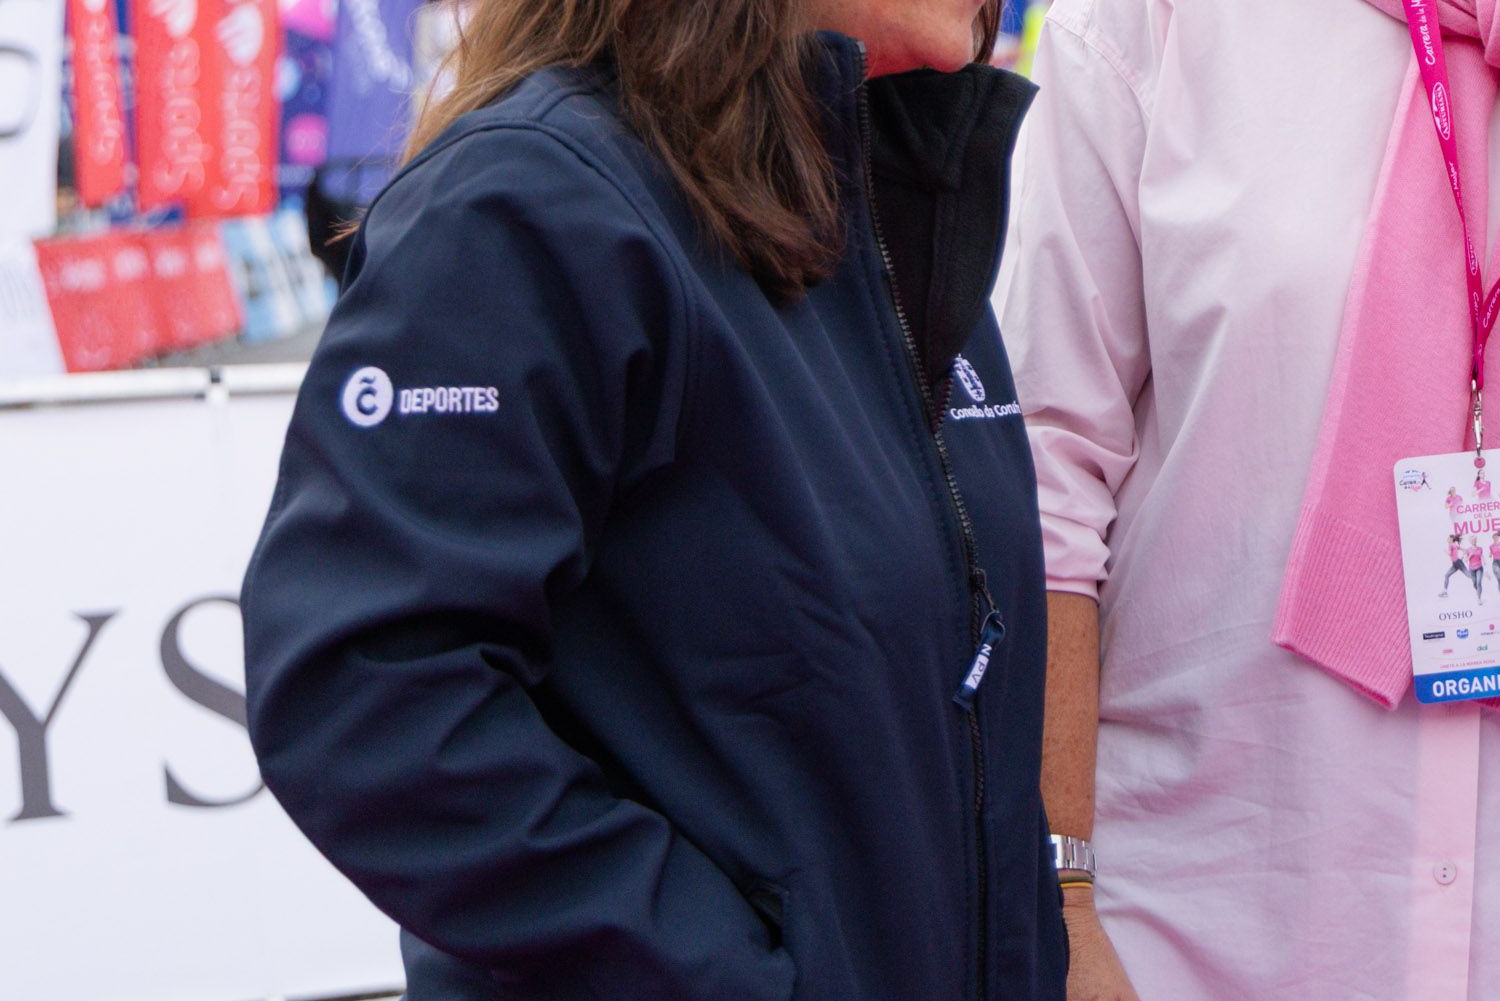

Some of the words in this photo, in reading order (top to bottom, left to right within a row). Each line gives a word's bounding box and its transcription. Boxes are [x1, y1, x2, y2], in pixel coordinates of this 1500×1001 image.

[1420, 25, 1436, 66] Carrera
[1482, 288, 1500, 328] Carrera
[400, 386, 499, 414] DEPORTES
[1438, 610, 1473, 621] OYSHO
